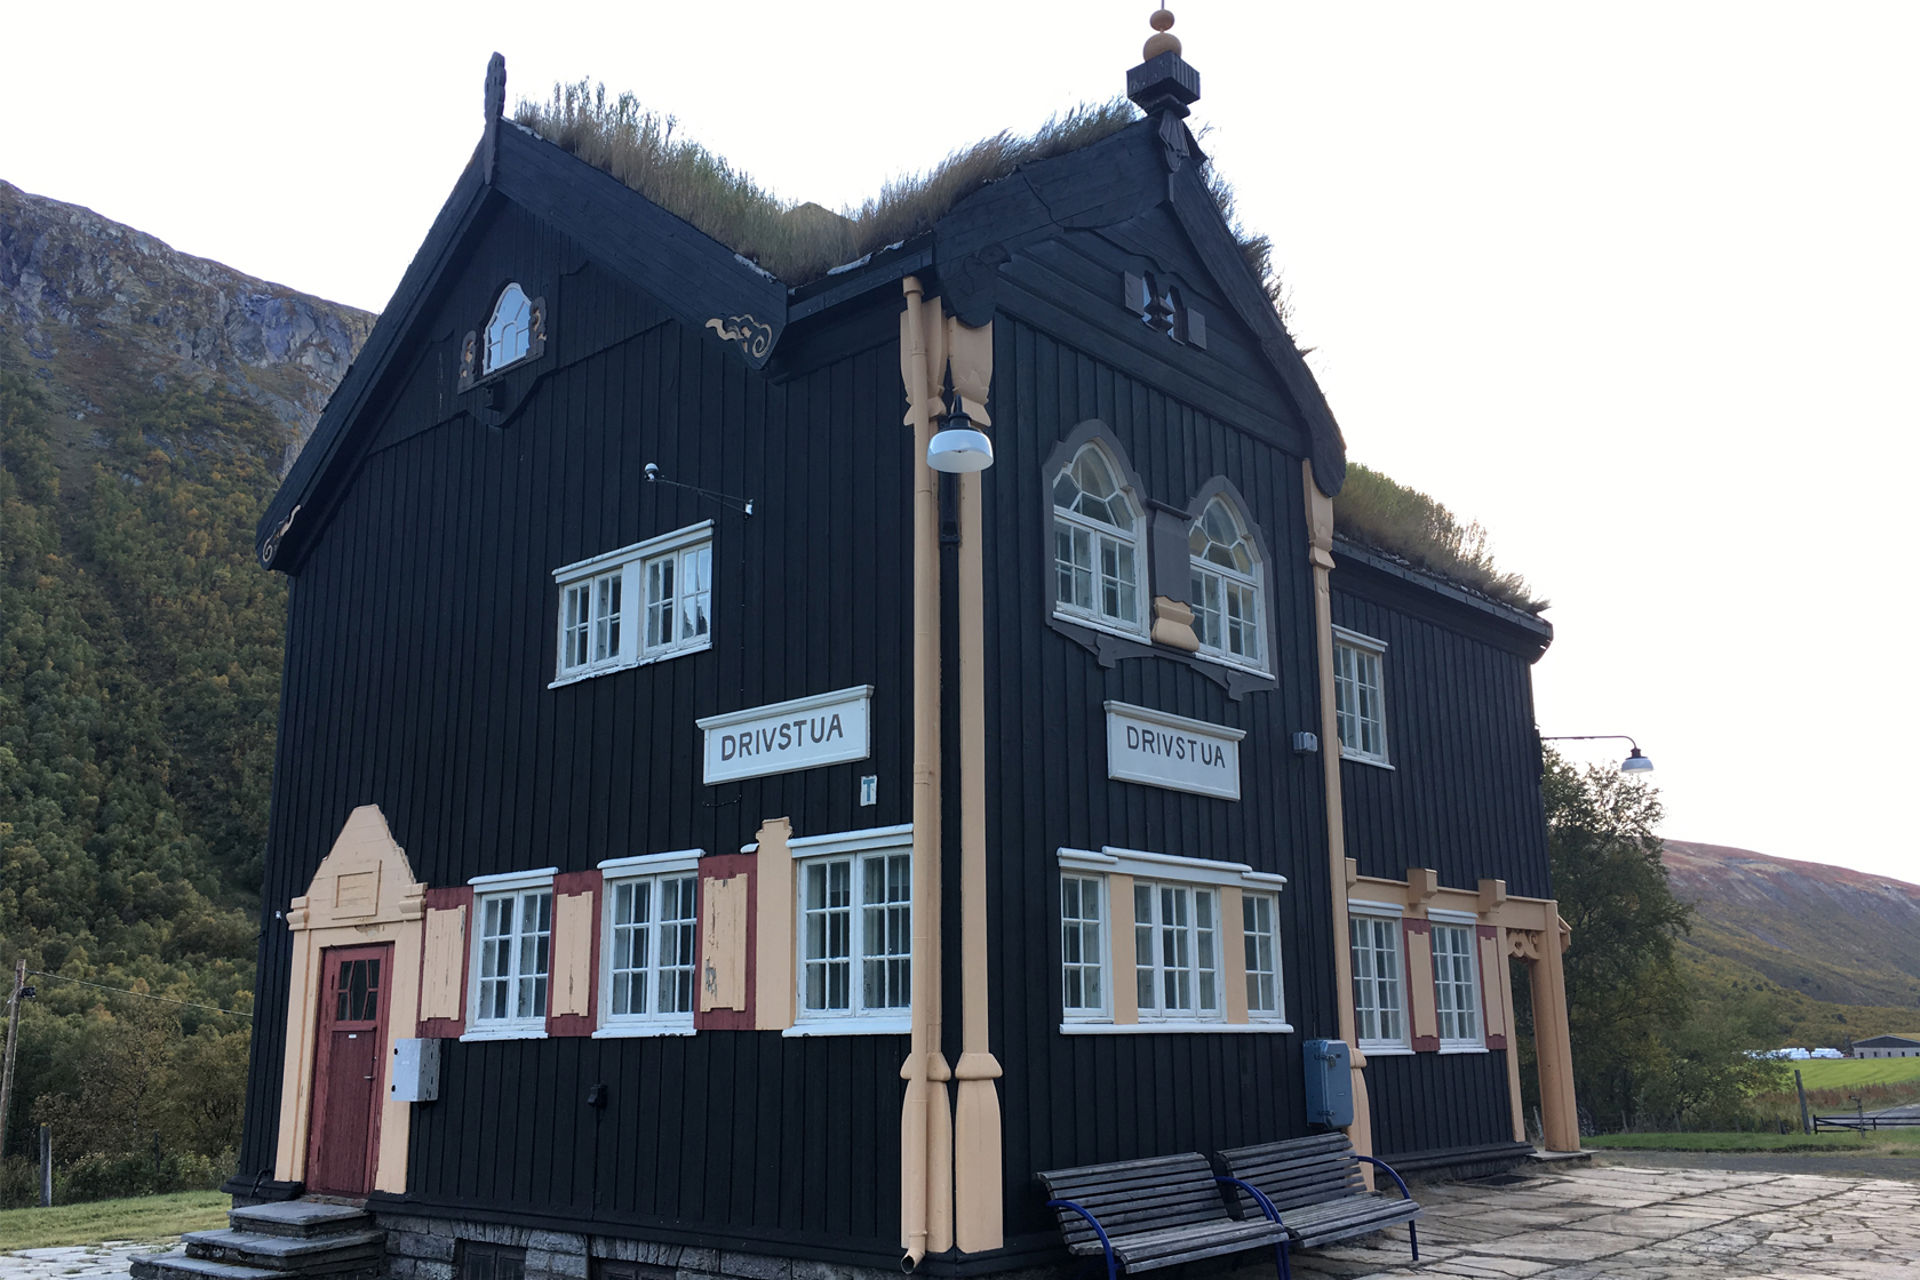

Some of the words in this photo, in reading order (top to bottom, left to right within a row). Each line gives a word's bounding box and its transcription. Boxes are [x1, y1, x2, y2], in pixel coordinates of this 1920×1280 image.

[720, 713, 844, 761] DRIVSTUA
[1126, 725, 1226, 768] DRIVSTUA
[862, 778, 876, 802] T
